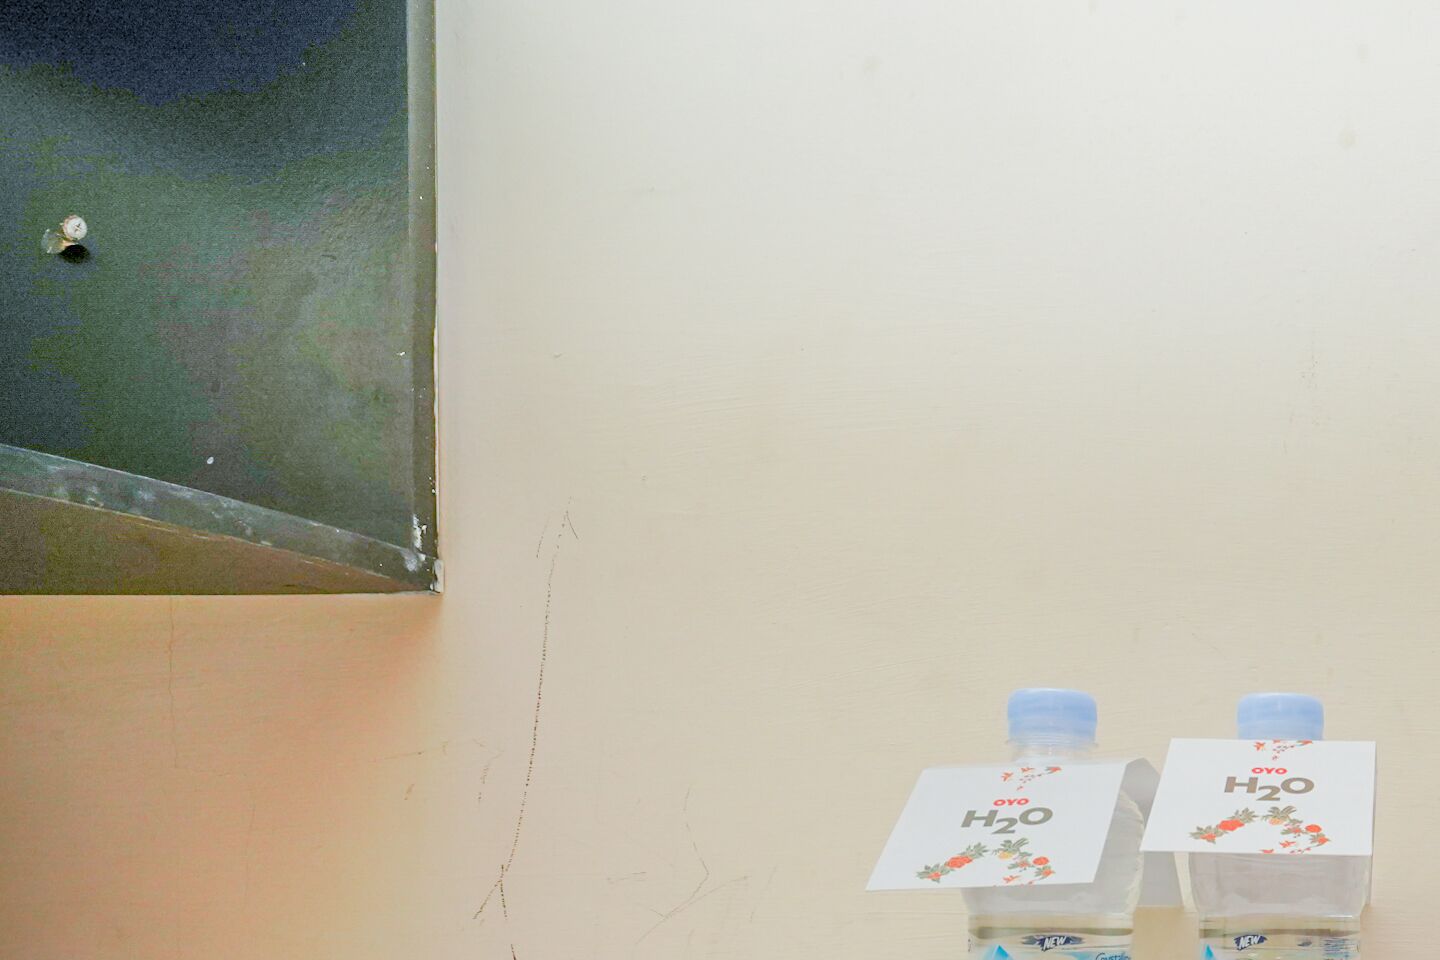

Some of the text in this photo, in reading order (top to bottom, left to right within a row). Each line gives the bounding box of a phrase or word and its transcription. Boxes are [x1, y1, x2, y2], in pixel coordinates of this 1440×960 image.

[1251, 767, 1288, 775] OYO
[1223, 776, 1315, 801] H2O
[993, 798, 1030, 806] OYO
[960, 806, 1054, 834] H2O
[1042, 935, 1067, 951] NEW
[1238, 934, 1261, 950] NEW
